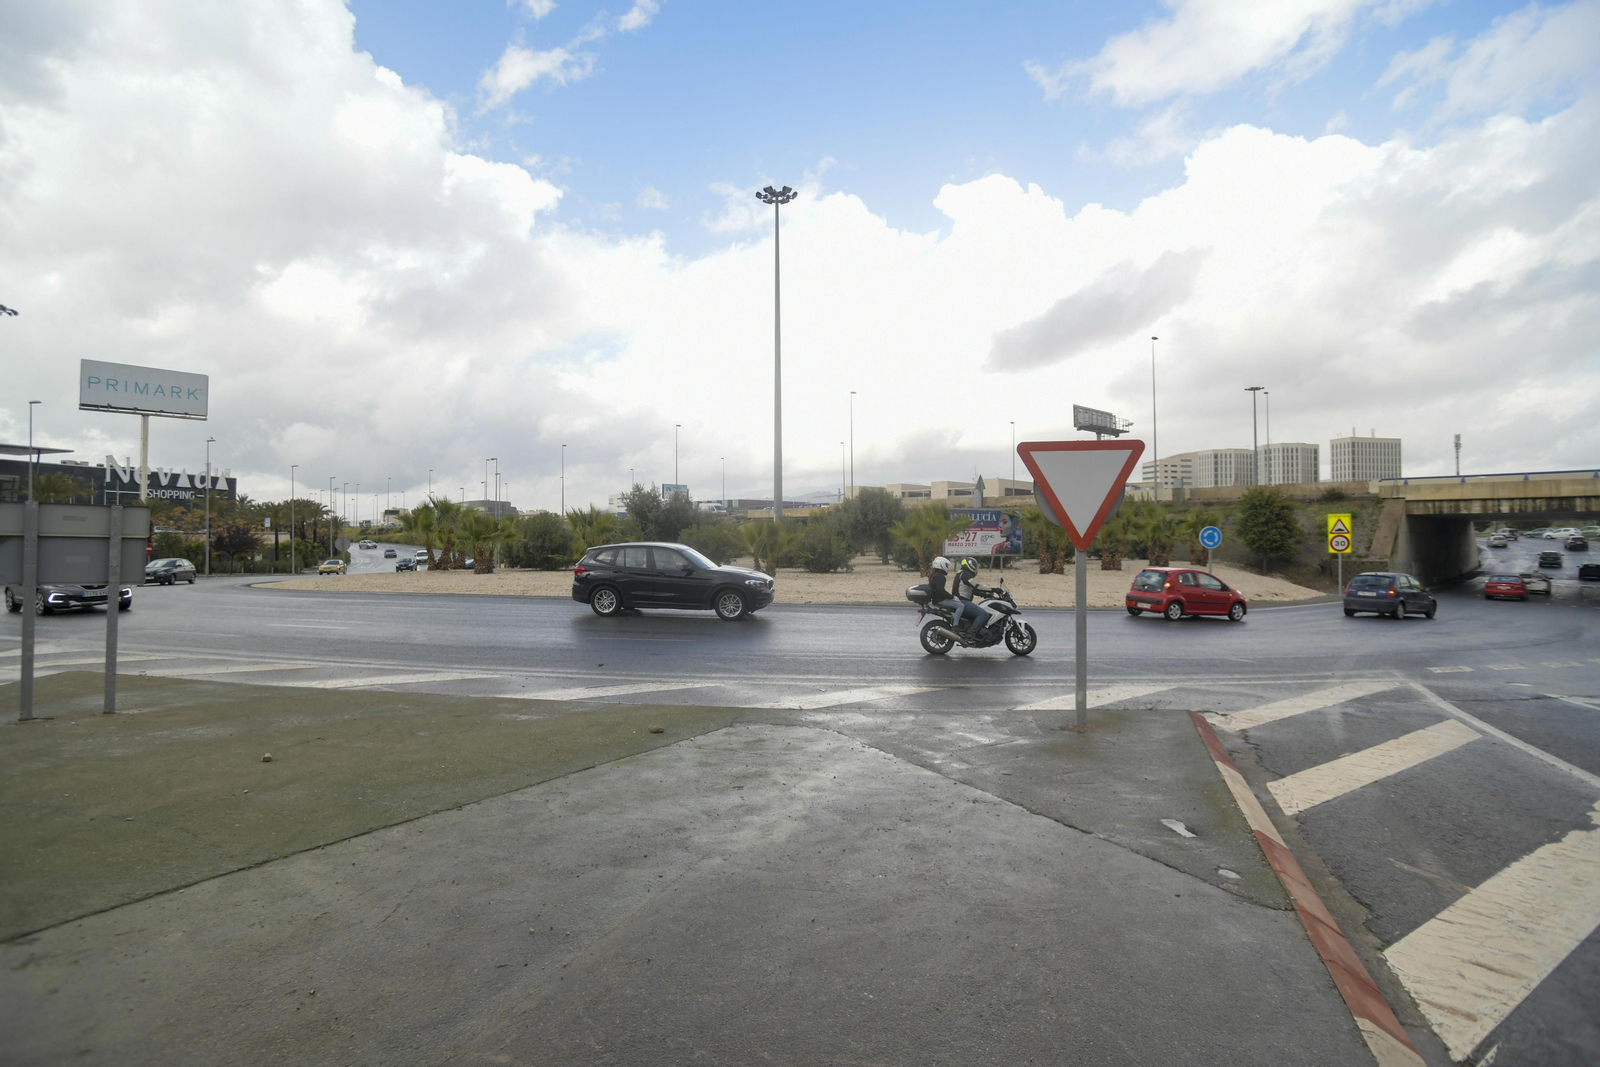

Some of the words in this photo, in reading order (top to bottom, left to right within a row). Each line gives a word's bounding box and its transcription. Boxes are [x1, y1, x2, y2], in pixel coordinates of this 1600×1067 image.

[87, 376, 199, 401] PRIMARK
[146, 488, 195, 500] SHOPPING
[948, 532, 977, 541] 5-27
